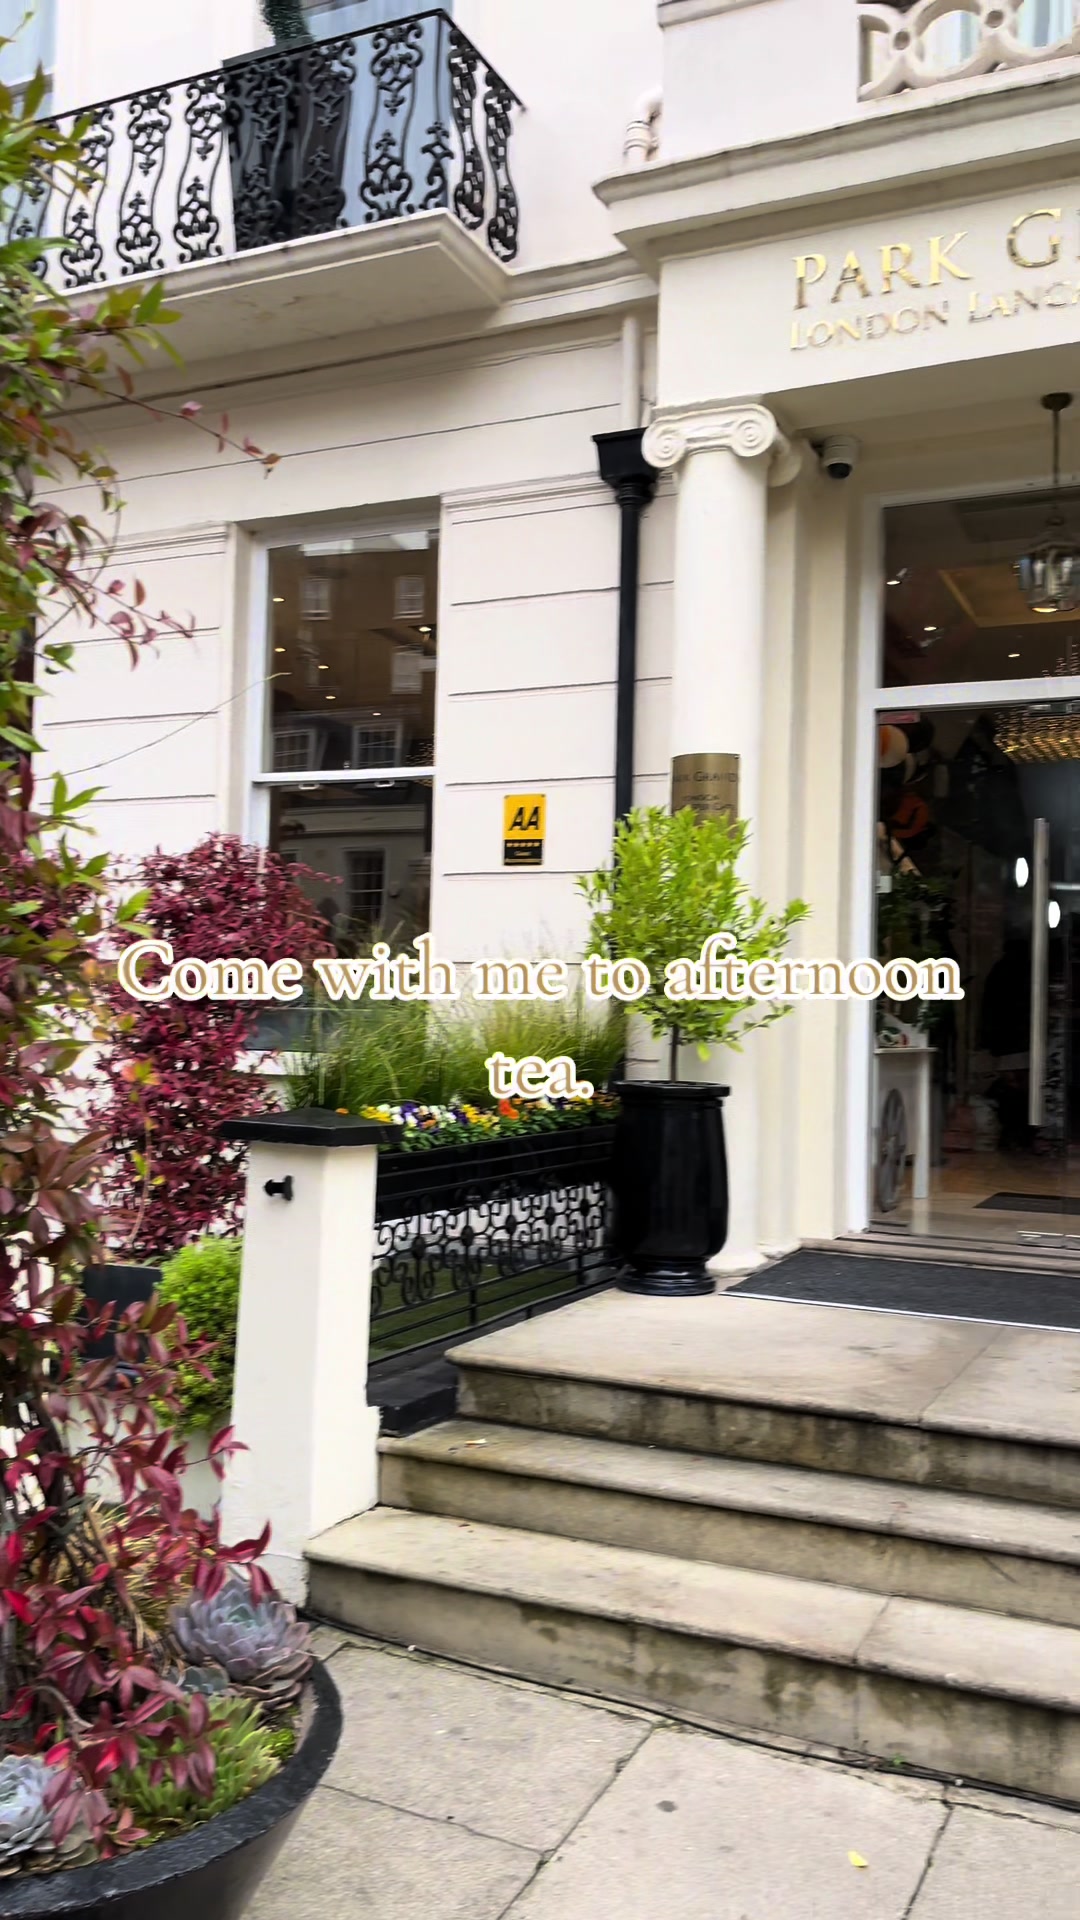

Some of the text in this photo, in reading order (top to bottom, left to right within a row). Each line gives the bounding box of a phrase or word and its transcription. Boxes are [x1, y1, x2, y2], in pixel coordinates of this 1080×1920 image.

[791, 207, 1080, 311] PARK G
[789, 299, 949, 351] LONDON
[508, 805, 541, 831] AA
